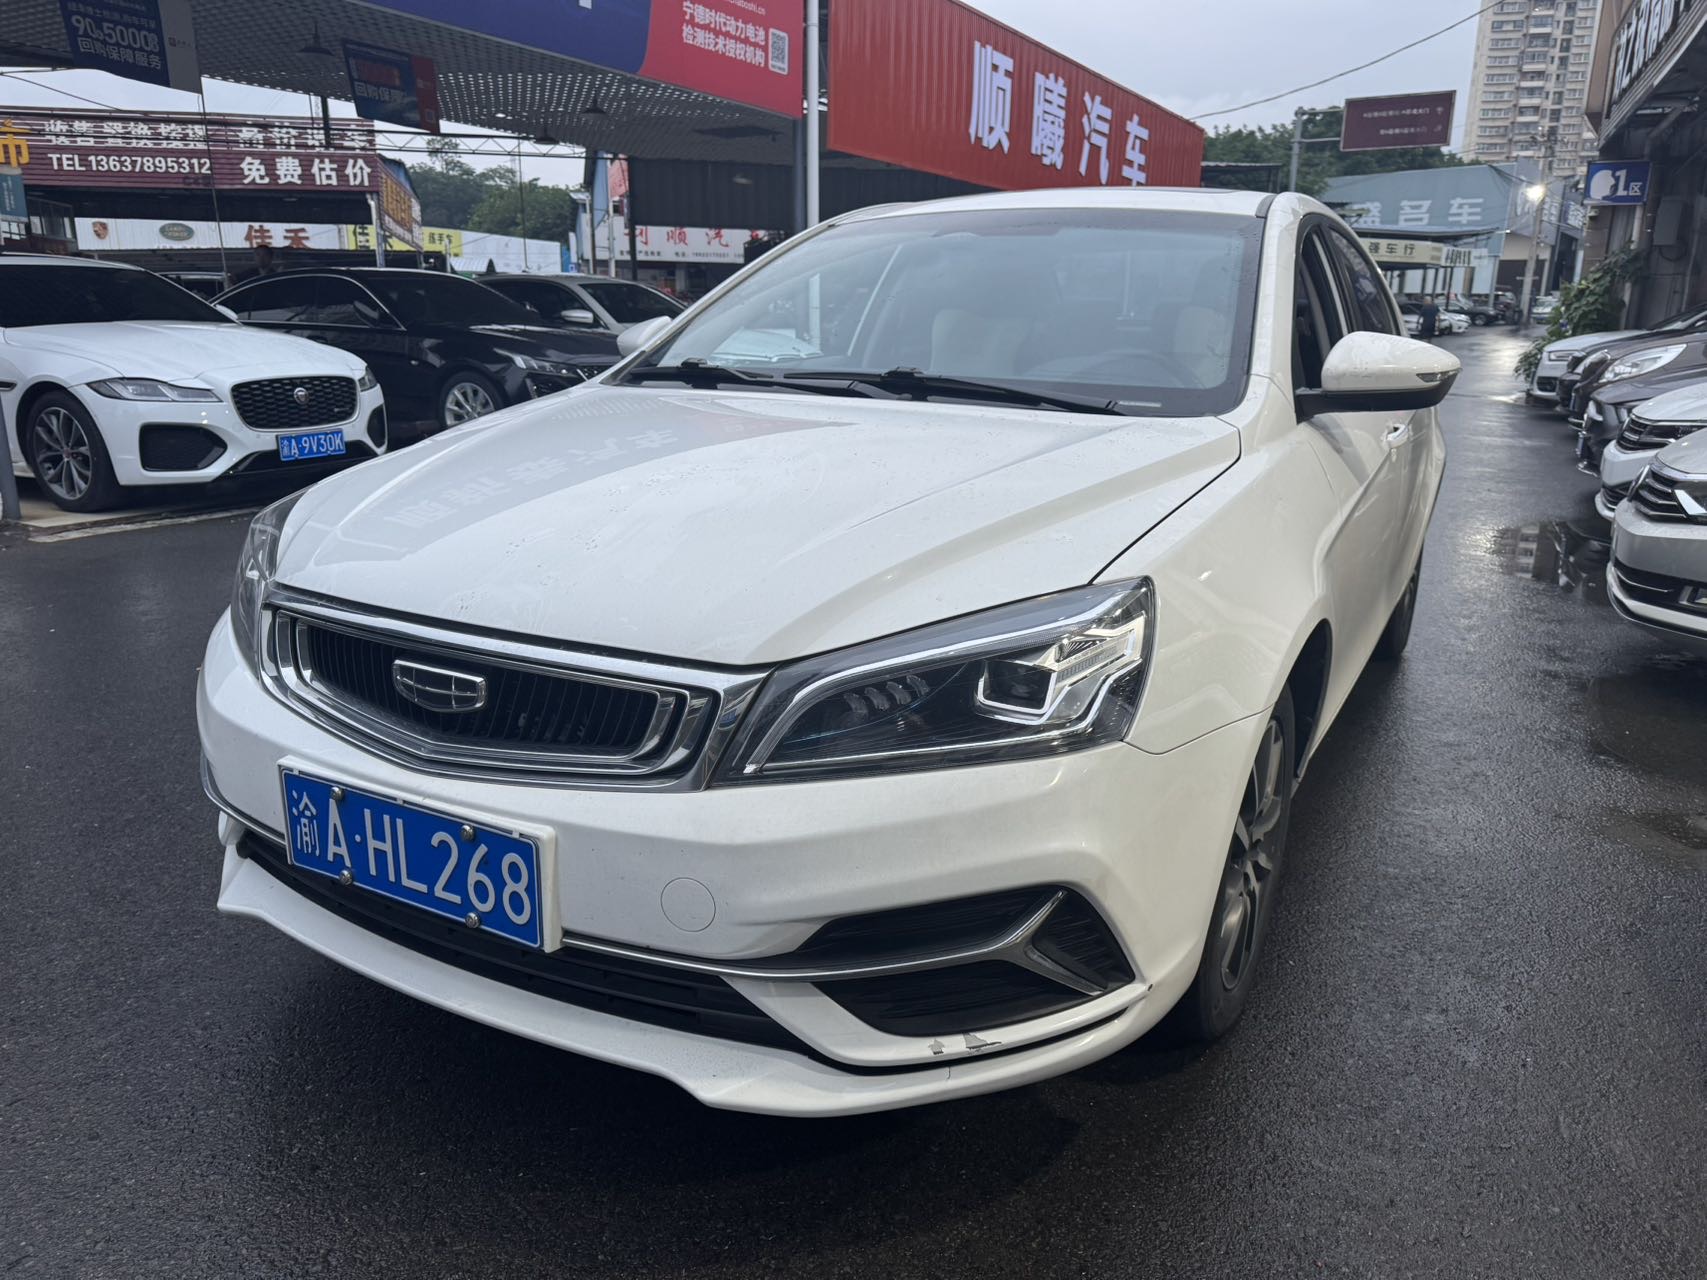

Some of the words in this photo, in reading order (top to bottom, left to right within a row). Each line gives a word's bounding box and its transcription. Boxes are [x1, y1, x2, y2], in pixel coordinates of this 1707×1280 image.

[682, 1, 765, 45] 宁德时代动力电池
[682, 23, 765, 67] 检测技术授权机构
[969, 40, 1150, 187] 顺曦汽车
[239, 156, 371, 187] 免费估价
[291, 788, 532, 925] 渝A·HL268
